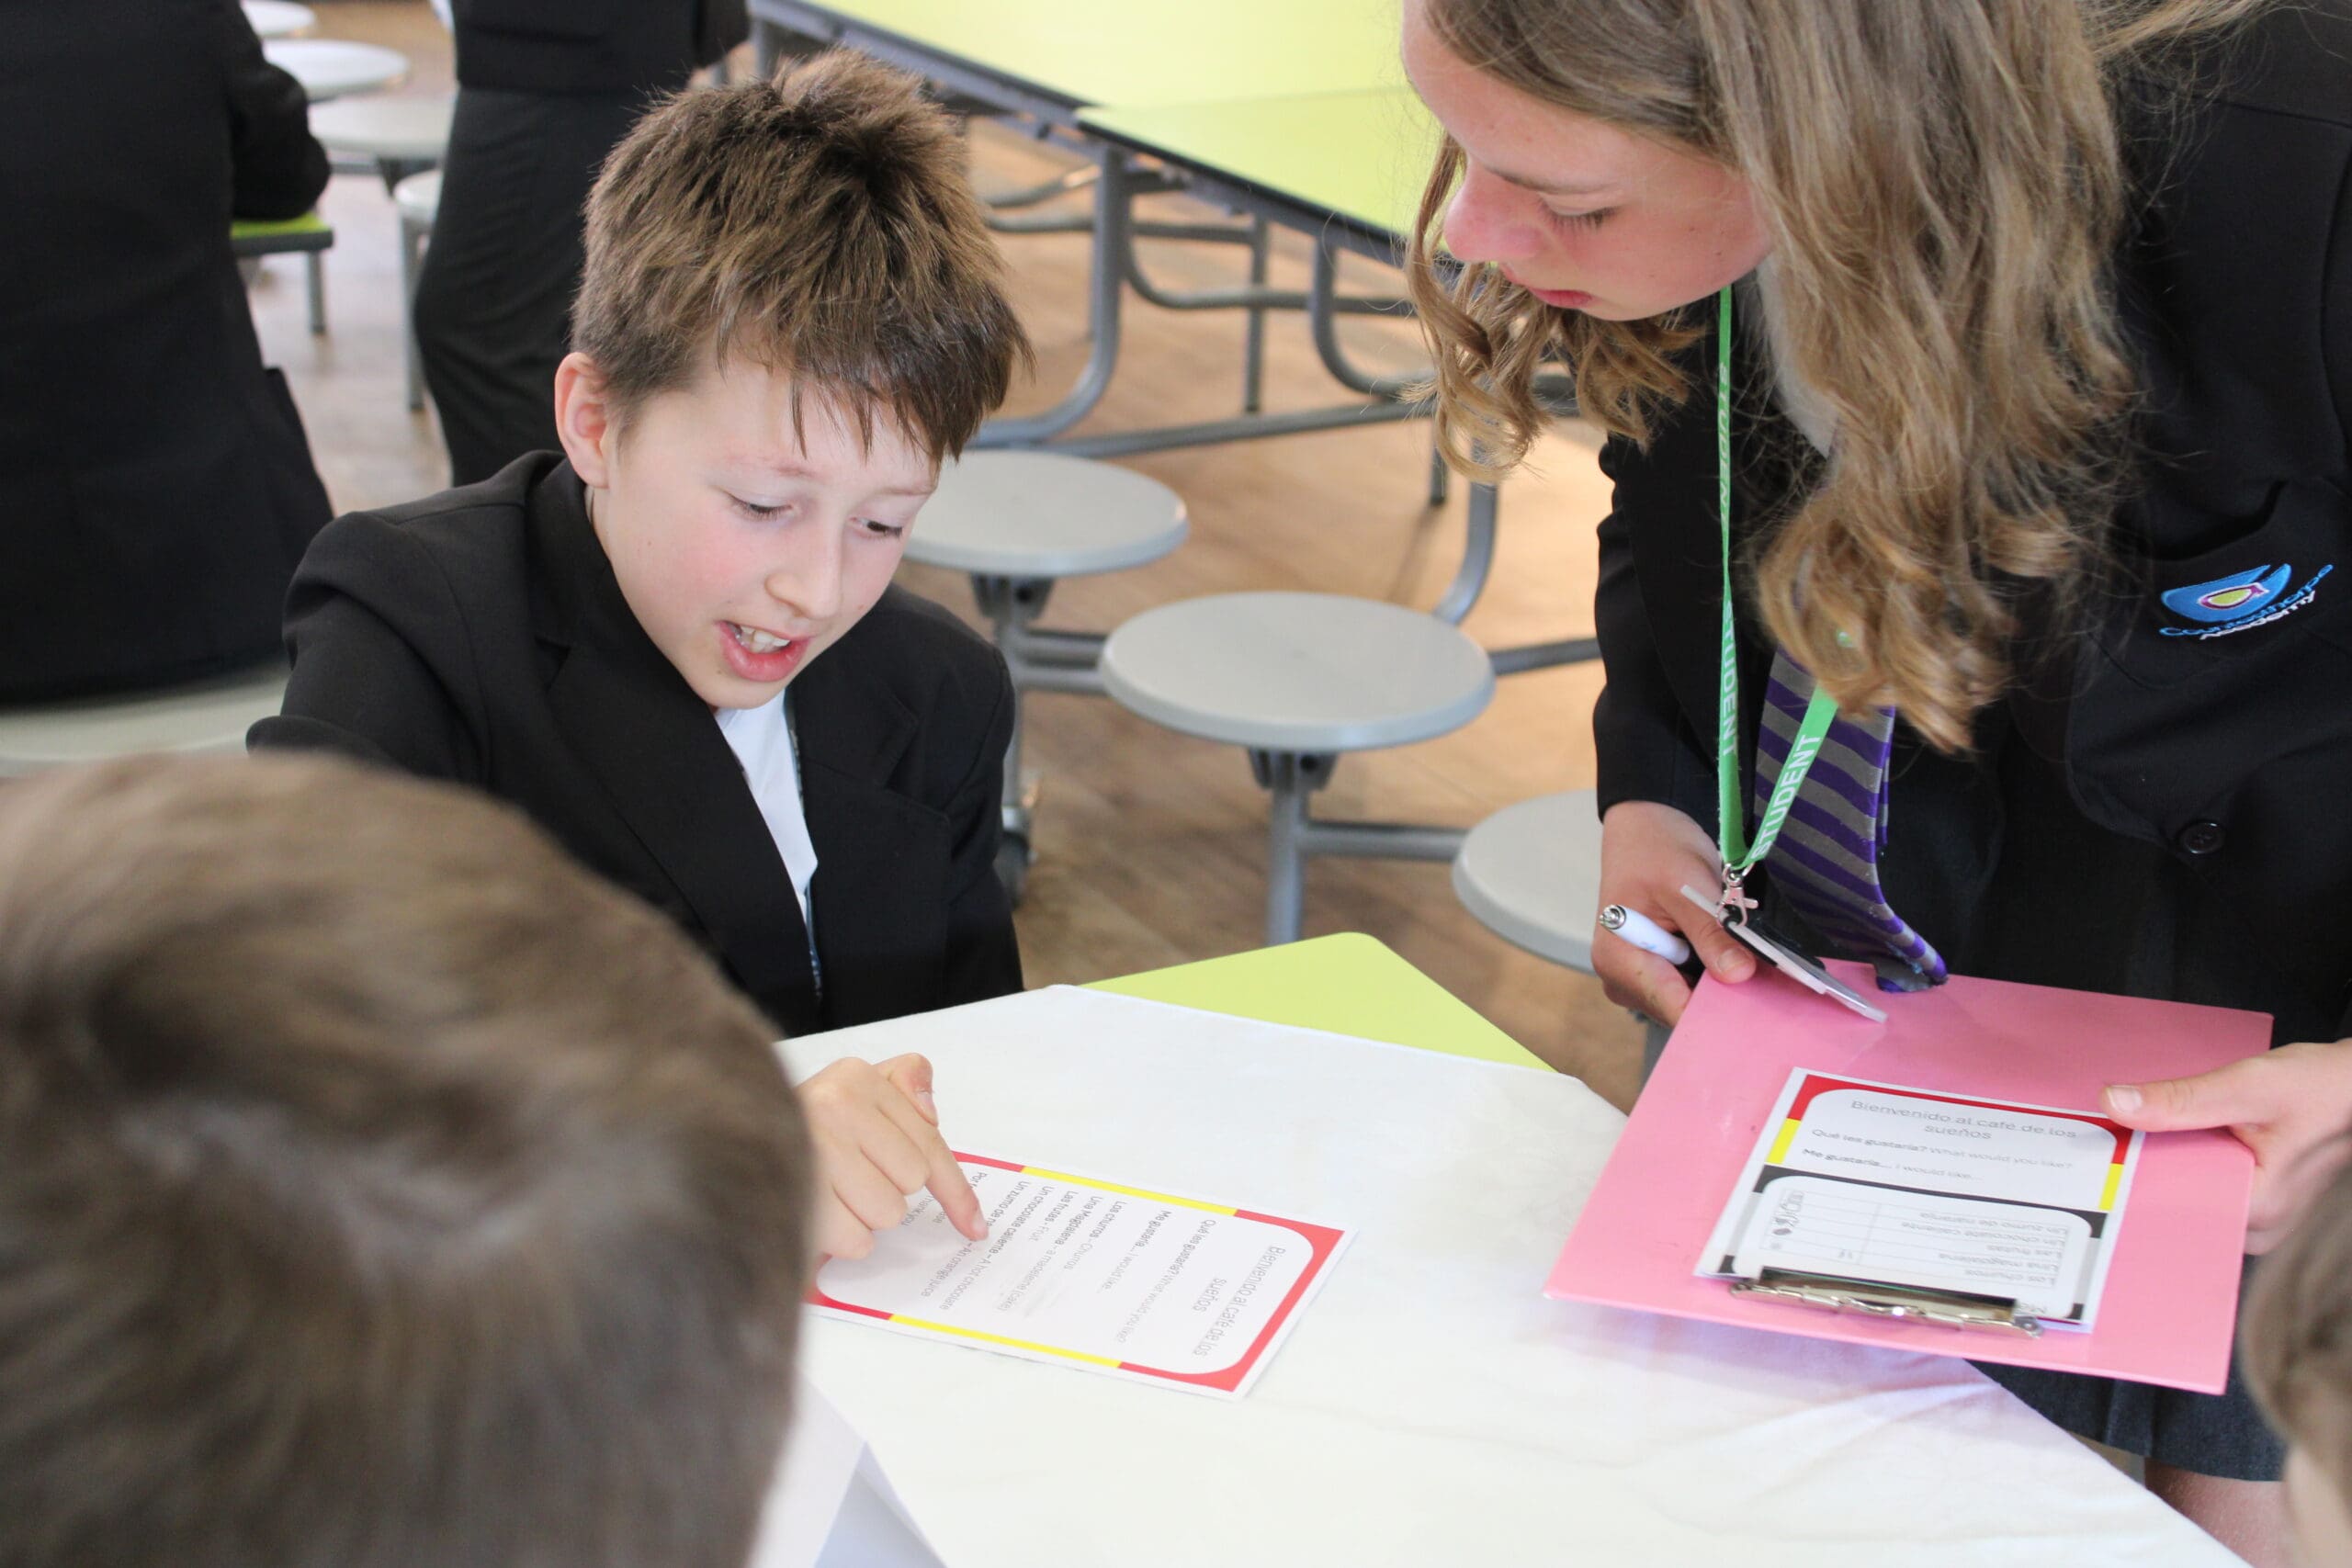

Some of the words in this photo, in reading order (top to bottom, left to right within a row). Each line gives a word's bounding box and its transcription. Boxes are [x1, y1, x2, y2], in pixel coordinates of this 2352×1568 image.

[1721, 599, 1738, 758] STUDENT
[1750, 734, 1822, 860] STUDENT
[1849, 1099, 1952, 1123] Bienvenido
[1954, 1115, 1973, 1125] al
[2021, 1123, 2044, 1134] de
[2048, 1127, 2077, 1138] los
[1923, 1122, 1993, 1141] sueños
[1800, 1148, 1825, 1157] Me
[1841, 1133, 1864, 1143] les
[1967, 1149, 2010, 1163] would
[2011, 1156, 2038, 1167] you
[1012, 1179, 1031, 1191] Un
[1036, 1185, 1055, 1196] Un
[997, 1190, 1020, 1209] zumo
[1059, 1190, 1079, 1203] Las
[1082, 1195, 1102, 1210] Una
[989, 1208, 1007, 1218] de
[1009, 1194, 1046, 1228] chocolate
[1043, 1201, 1069, 1223] frutas
[1107, 1200, 1127, 1213] Los
[1153, 1209, 1172, 1222] Me
[898, 1213, 918, 1226] you
[1051, 1208, 1092, 1246] Magdalena
[1087, 1212, 1119, 1239] churros
[1193, 1217, 1218, 1234] Qué
[988, 1226, 1020, 1255] caliente
[1188, 1233, 1207, 1245] les
[1963, 1228, 2040, 1247] chocolate
[1061, 1241, 1094, 1270] Churros
[1163, 1243, 1199, 1275] gustaría?
[932, 1255, 963, 1280] orange
[967, 1263, 988, 1277] hot
[1109, 1255, 1136, 1278] would
[1236, 1245, 1287, 1297] Bienvenido
[1151, 1273, 1176, 1293] What
[938, 1275, 978, 1312] chocolate
[1135, 1292, 1160, 1314] would
[1191, 1277, 1232, 1314] sueños
[1229, 1295, 1250, 1306] al
[1123, 1312, 1143, 1326] you
[1213, 1306, 1244, 1328] café
[1202, 1327, 1227, 1342] de
[1191, 1340, 1217, 1358] los
